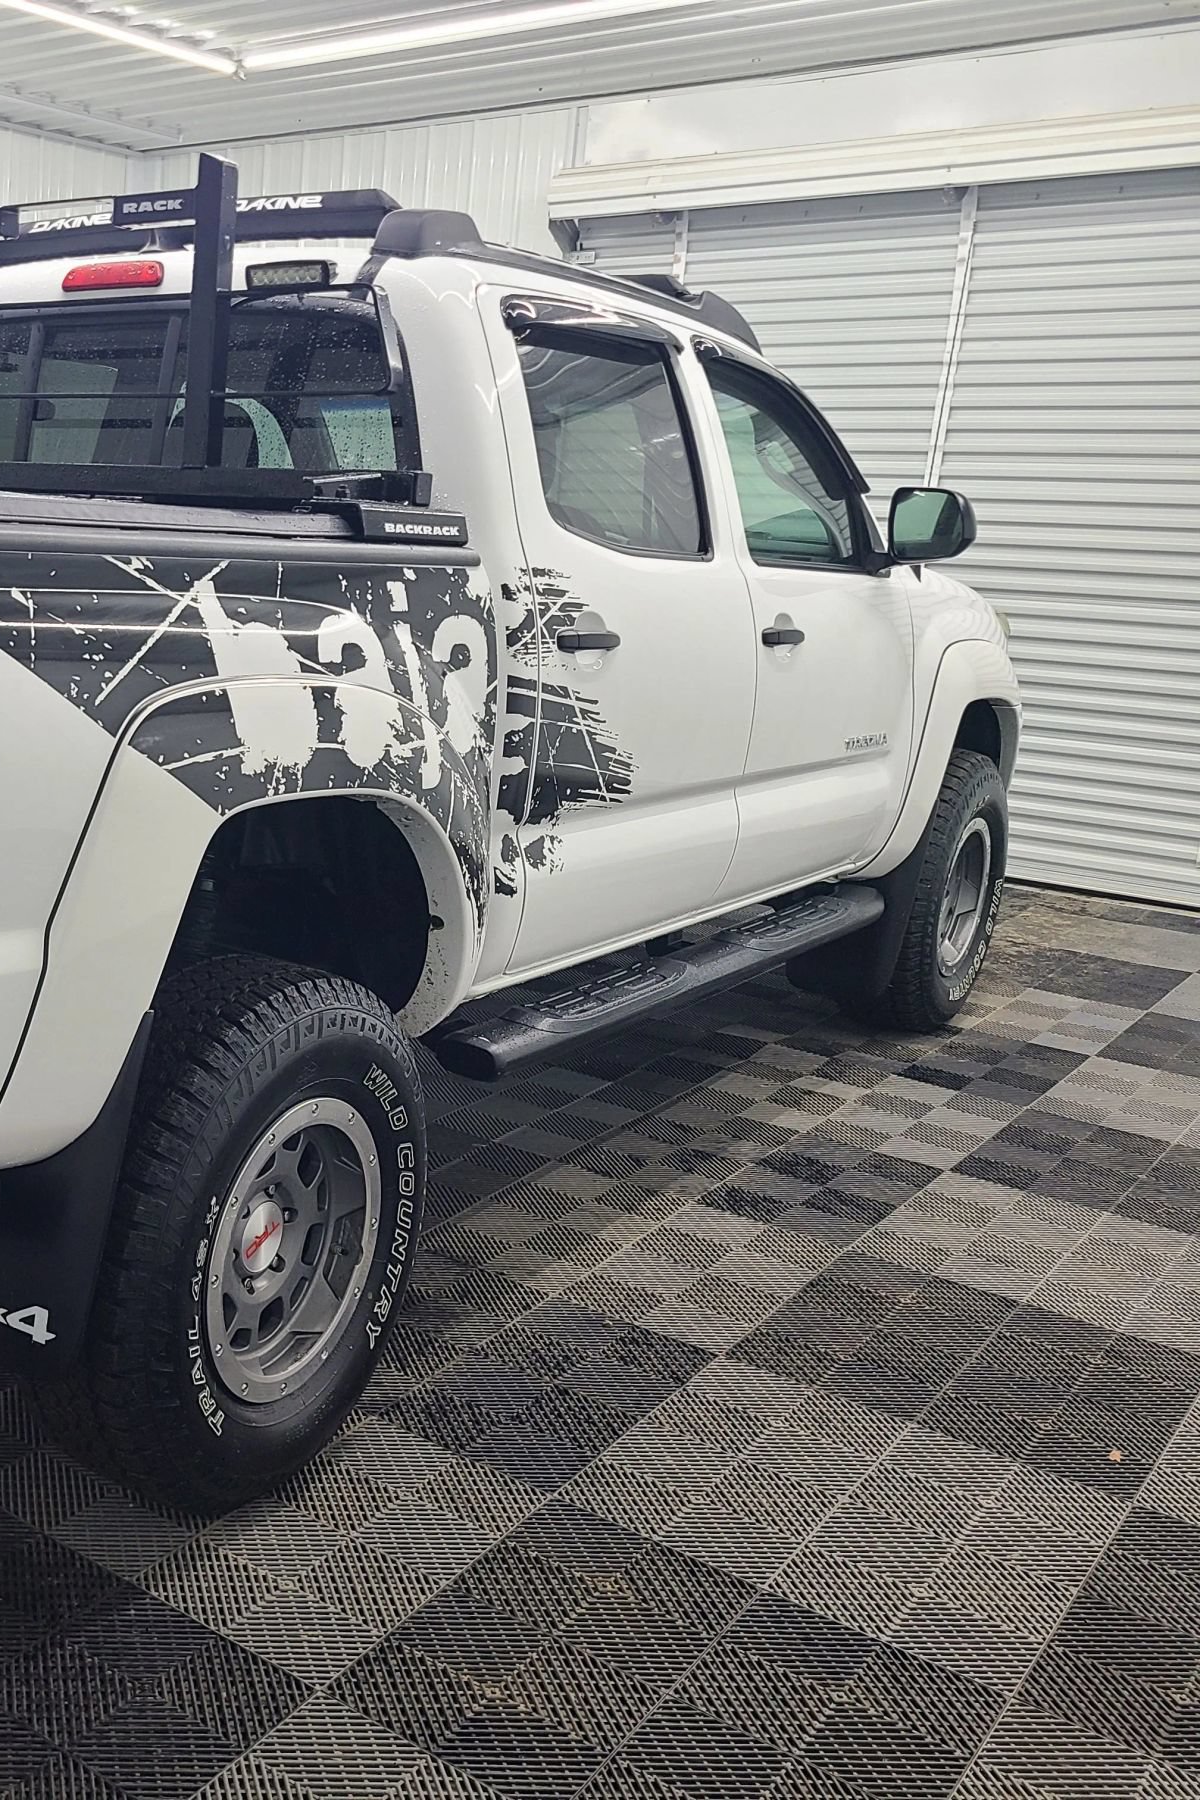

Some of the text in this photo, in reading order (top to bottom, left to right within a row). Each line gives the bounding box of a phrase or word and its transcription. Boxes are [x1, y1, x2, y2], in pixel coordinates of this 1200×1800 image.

[28, 212, 113, 234] DAKINE
[122, 198, 184, 214] RACK
[384, 522, 460, 536] BACKRACK
[985, 878, 1004, 936] WILD
[363, 1062, 415, 1350] WILD COUNTRY
[245, 1221, 280, 1260] TRD
[188, 1314, 225, 1436] TRAIL
